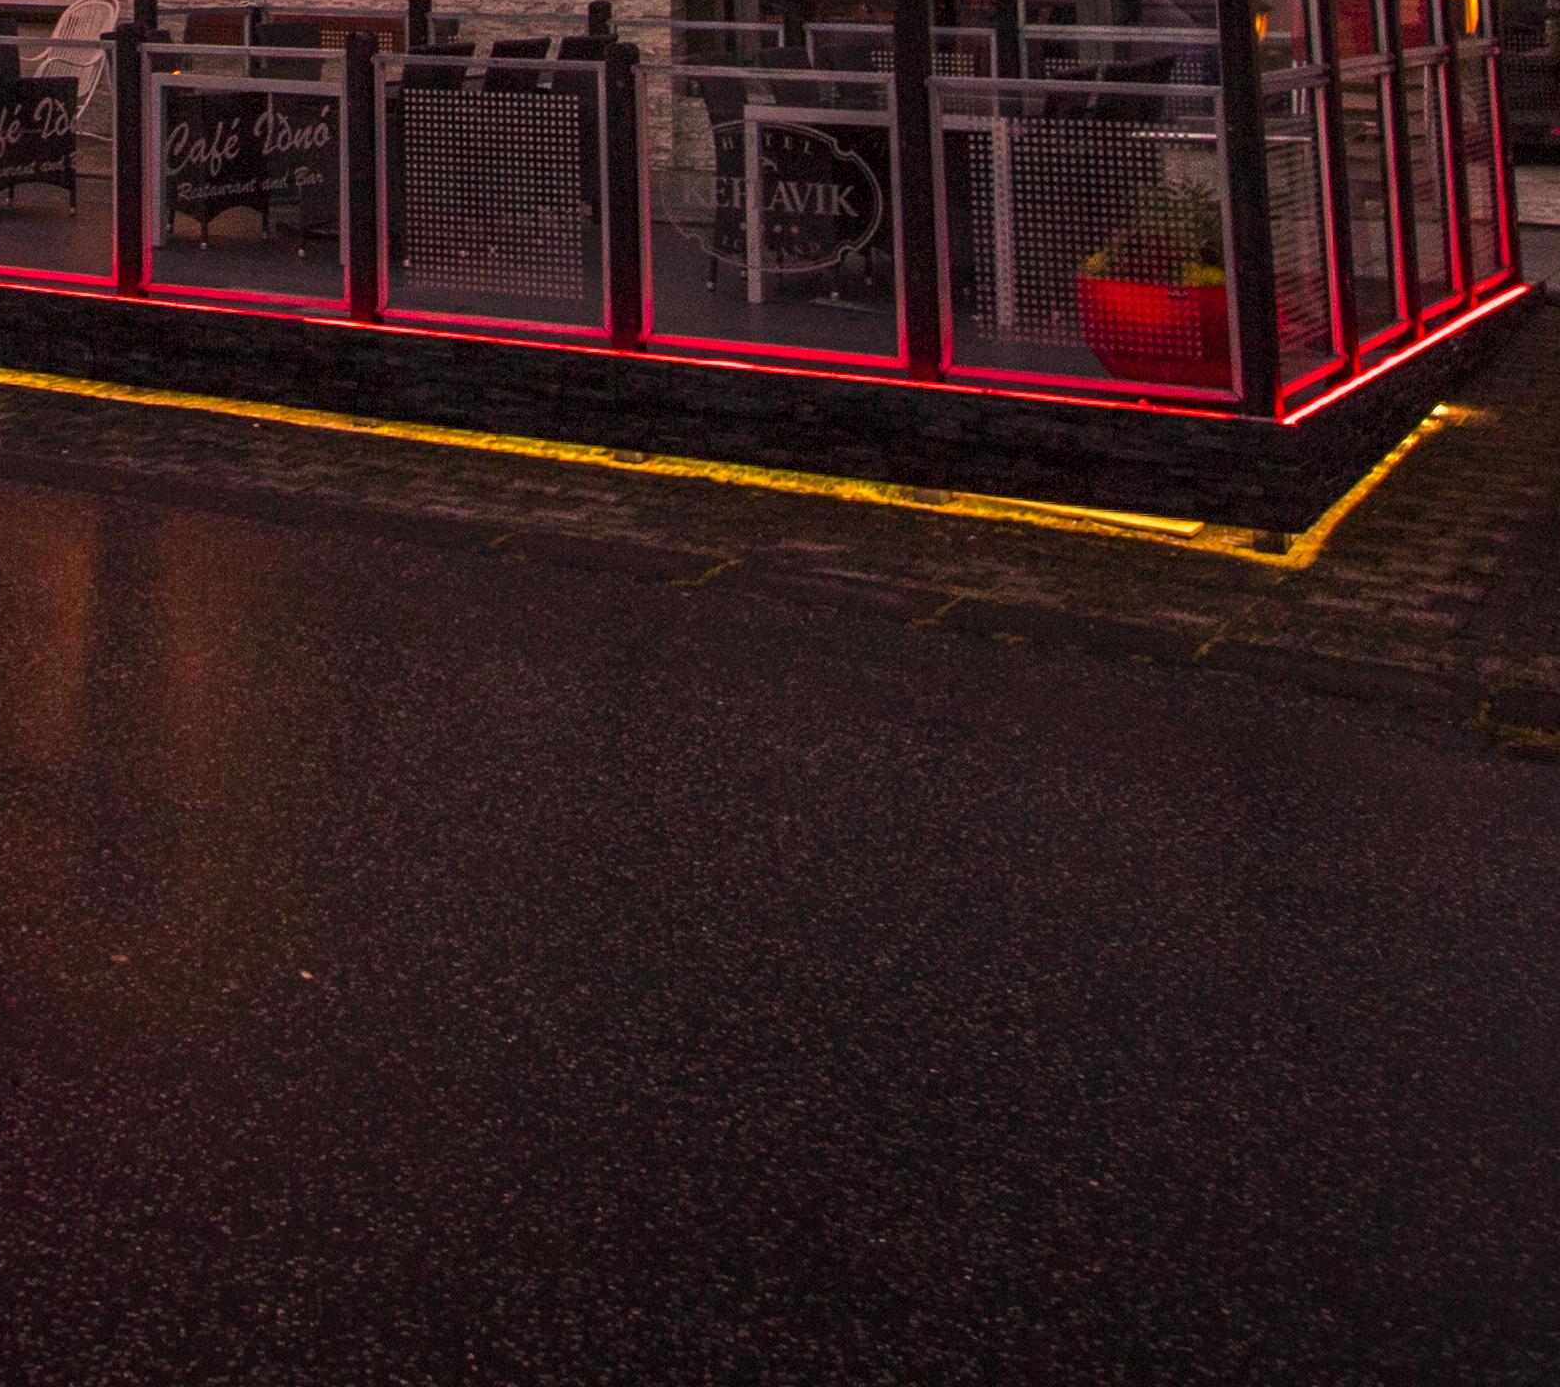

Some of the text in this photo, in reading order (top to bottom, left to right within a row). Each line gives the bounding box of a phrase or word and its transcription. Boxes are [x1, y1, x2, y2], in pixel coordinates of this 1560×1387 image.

[164, 105, 331, 177] Café Iðnó
[683, 175, 860, 219] KEFAVIK
